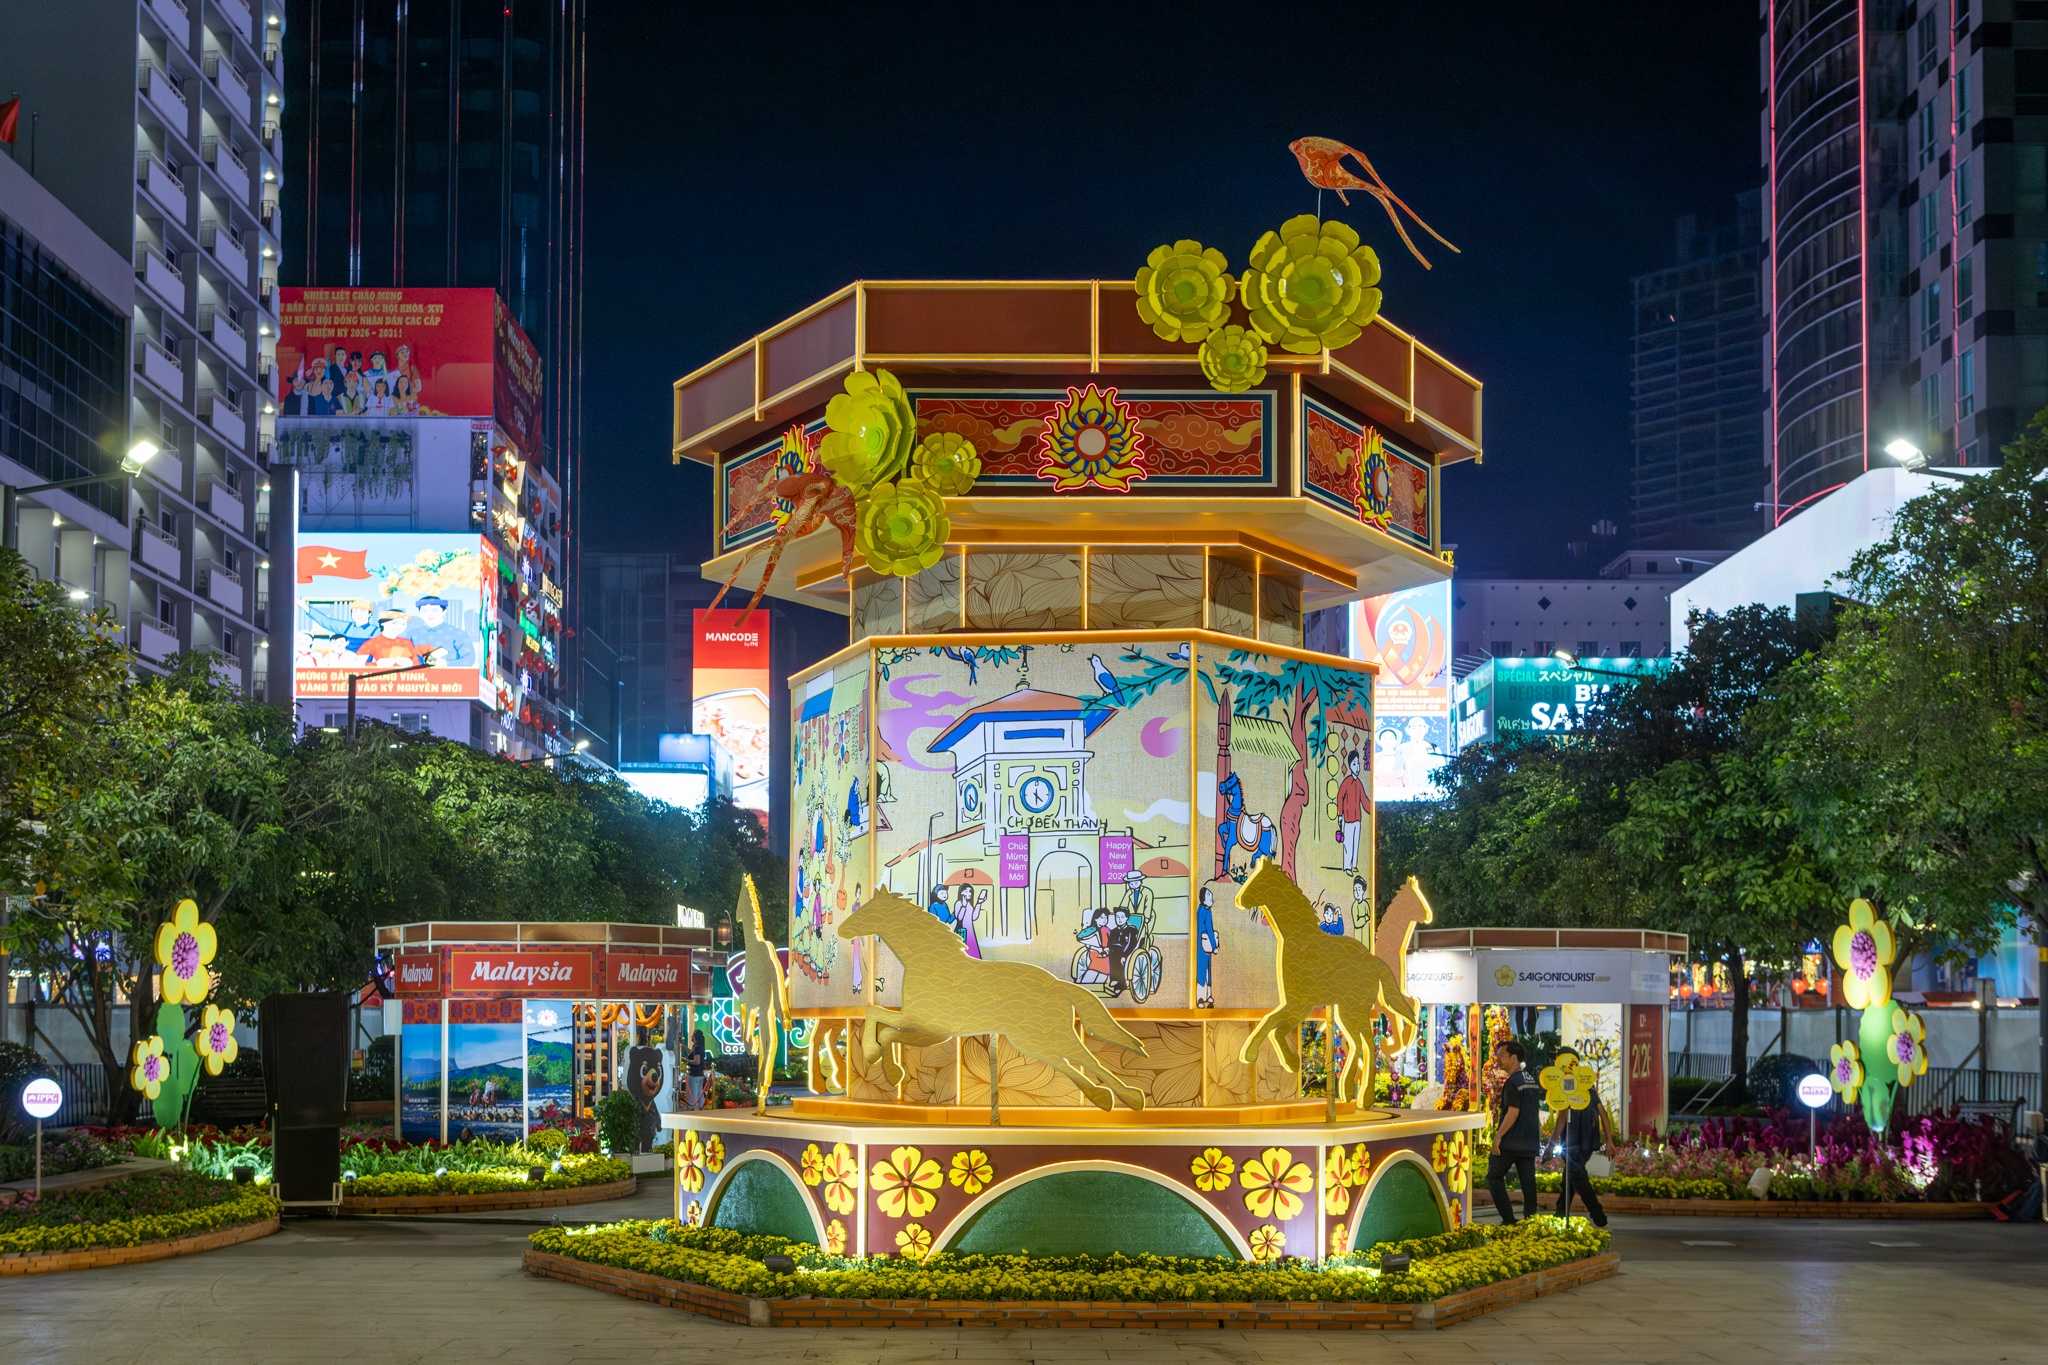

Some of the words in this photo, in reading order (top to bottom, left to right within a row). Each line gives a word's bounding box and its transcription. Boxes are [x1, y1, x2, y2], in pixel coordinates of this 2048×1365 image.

[350, 328, 370, 338] 2026
[705, 632, 758, 642] MANCODE
[1539, 670, 1595, 682] スペシャル
[1007, 842, 1028, 850] Chúc
[1106, 841, 1132, 851] Happy
[1006, 852, 1028, 862] Mừng
[1109, 852, 1127, 860] New
[1008, 863, 1027, 871] Năm
[1107, 862, 1126, 870] Year
[1009, 872, 1024, 881] Mới
[401, 962, 433, 987] Malaysia
[470, 961, 572, 986] Malaysia
[618, 962, 678, 987] Malaysia
[1518, 972, 1595, 982] SAIGONTOURIST
